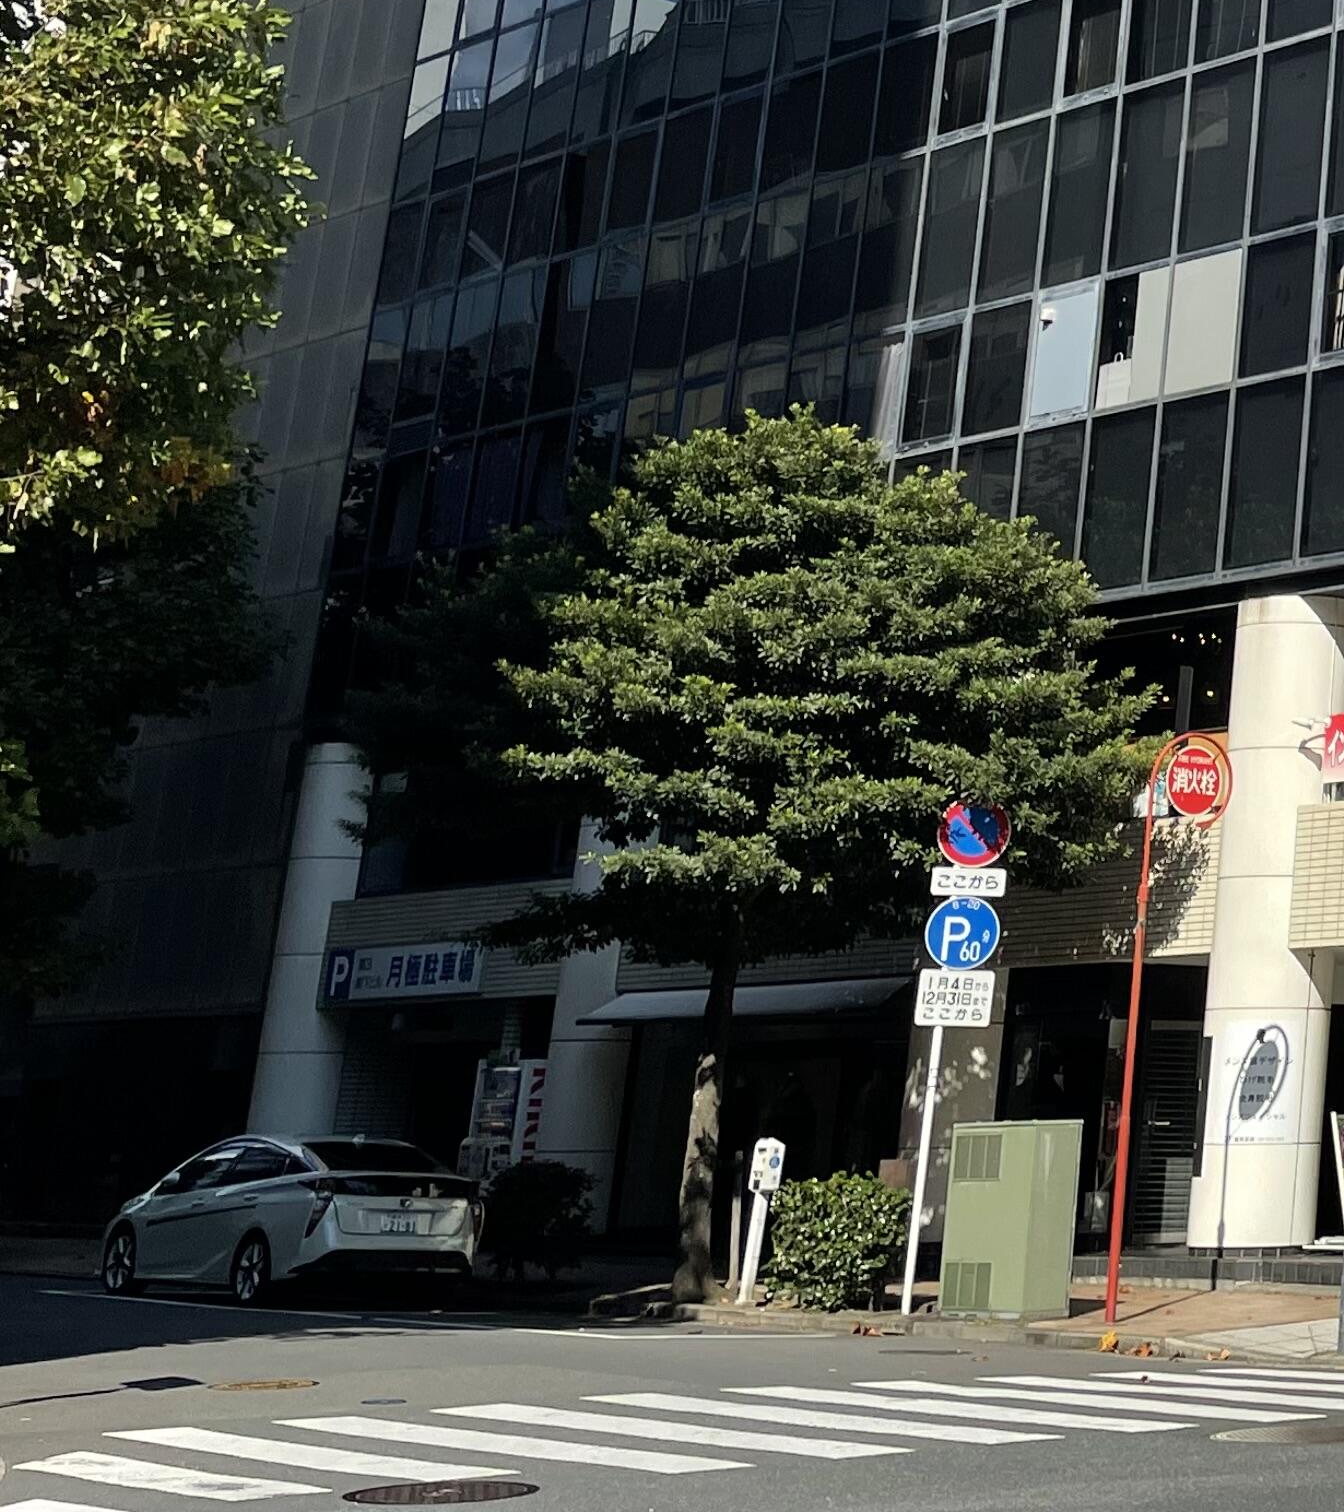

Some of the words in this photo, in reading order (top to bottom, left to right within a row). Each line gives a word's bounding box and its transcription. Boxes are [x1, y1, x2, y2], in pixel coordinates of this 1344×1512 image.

[1171, 766, 1218, 796] 消火栓
[937, 874, 999, 890] ここから
[952, 899, 981, 911] 8-20
[940, 915, 971, 962] P
[959, 941, 981, 962] 60
[982, 929, 991, 943] 分
[329, 956, 350, 997] P
[386, 949, 476, 988] 月極駐車場
[922, 991, 989, 1005] 12月31日まで
[922, 1008, 983, 1021] ここから
